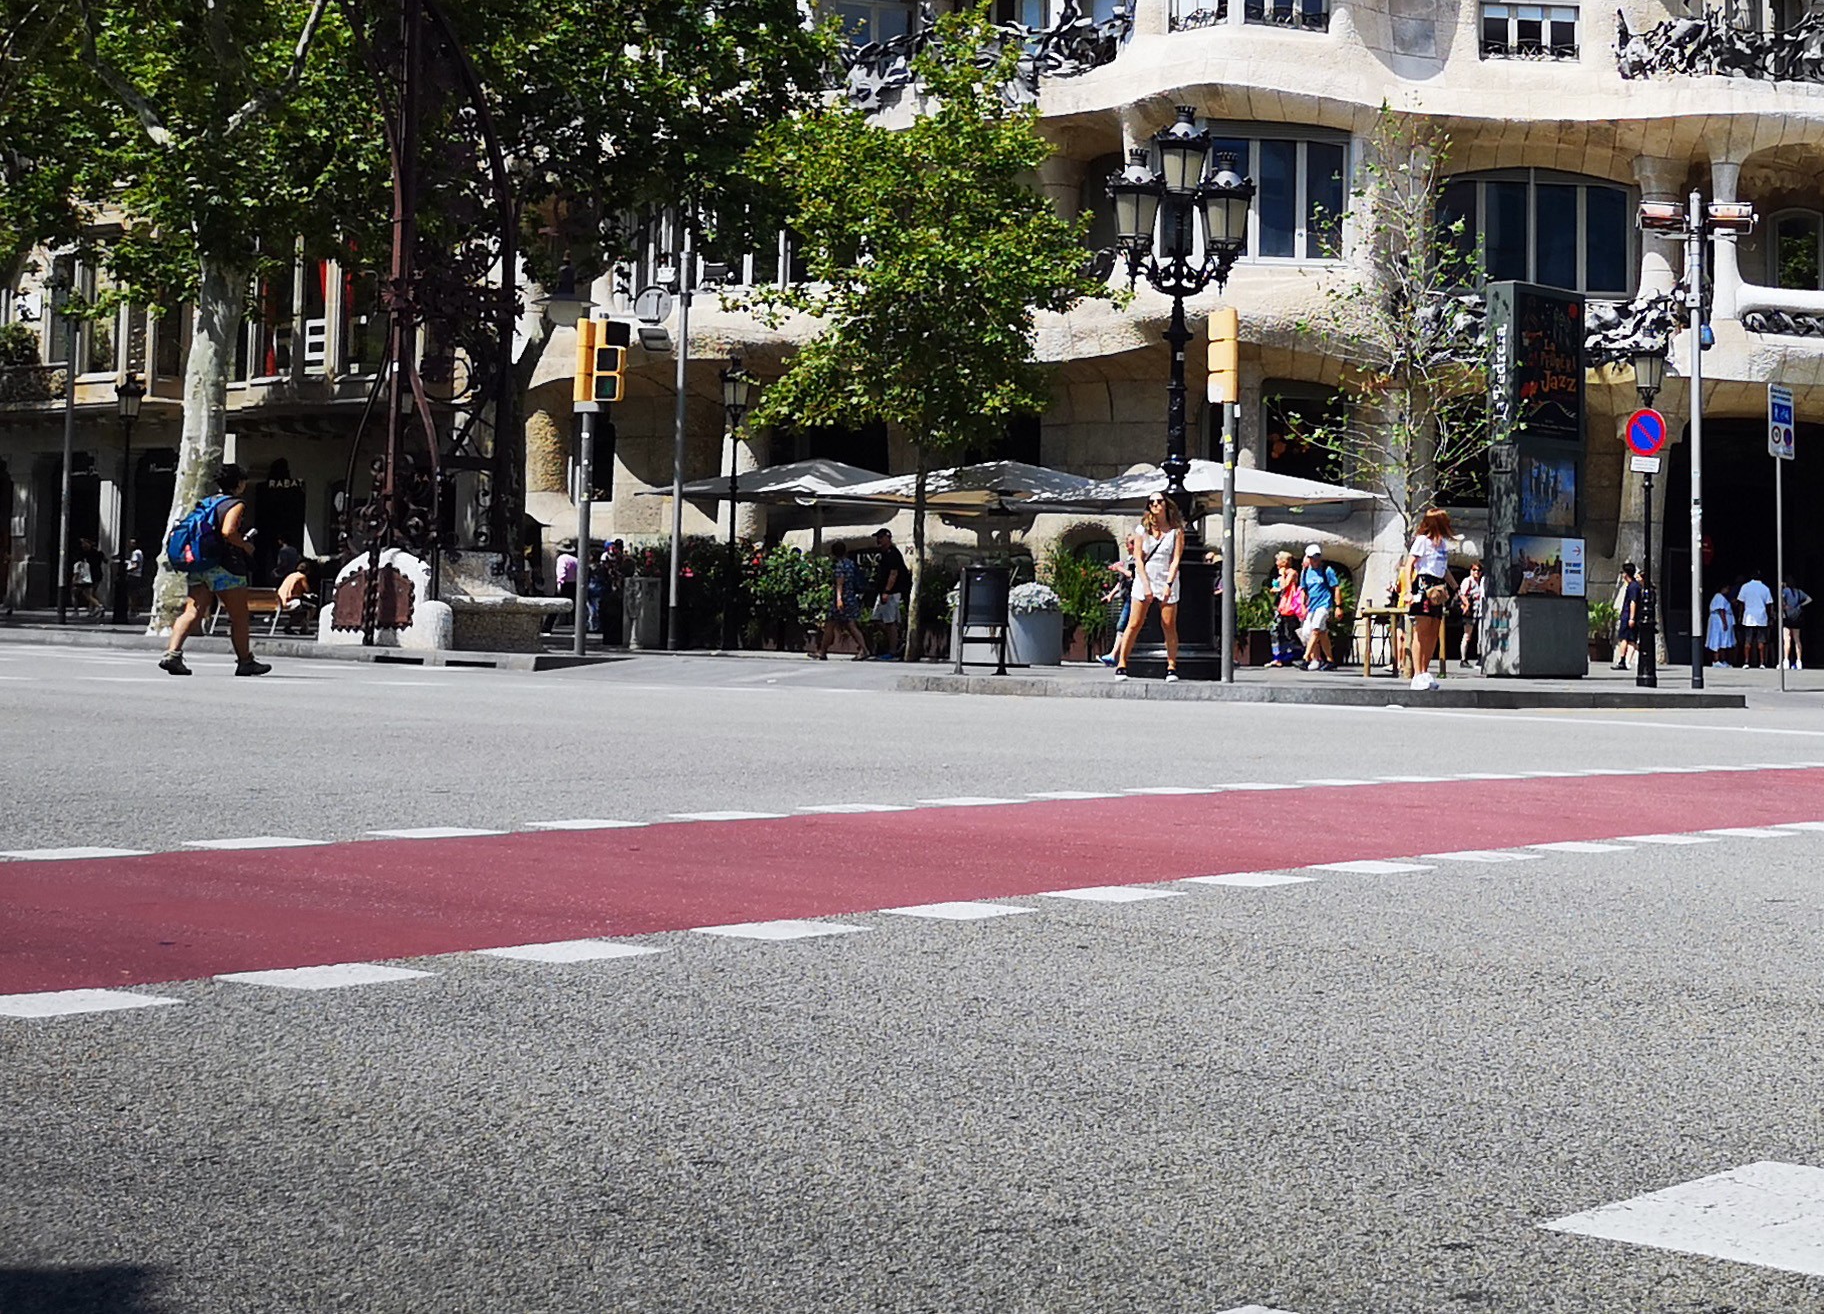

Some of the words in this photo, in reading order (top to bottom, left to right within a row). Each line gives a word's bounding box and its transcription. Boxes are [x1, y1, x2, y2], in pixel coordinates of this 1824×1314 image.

[1492, 323, 1508, 399] Pedrera
[1540, 370, 1577, 393] Jazz
[1493, 400, 1509, 421] La
[269, 478, 304, 488] RABAT
